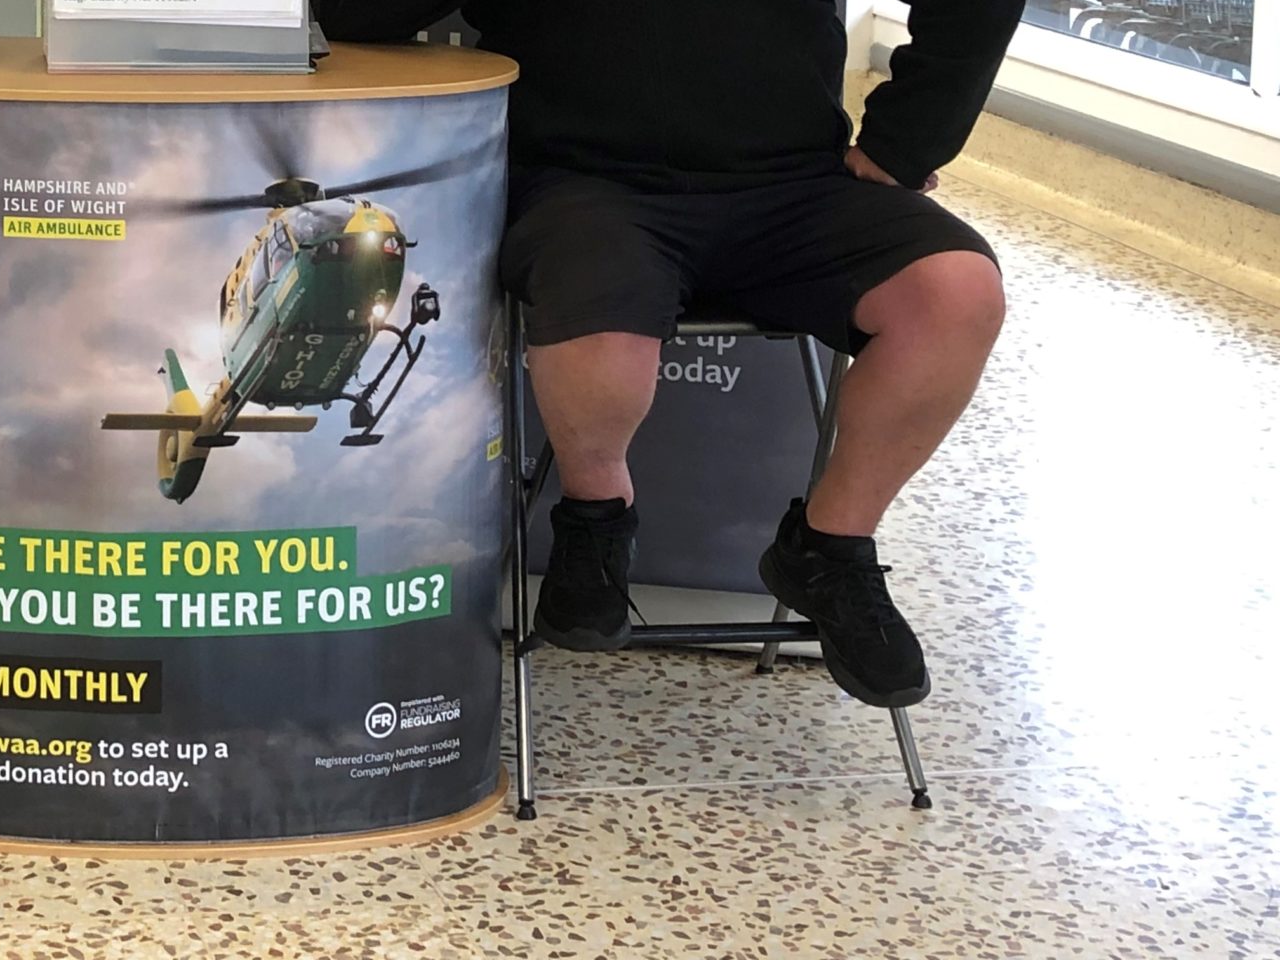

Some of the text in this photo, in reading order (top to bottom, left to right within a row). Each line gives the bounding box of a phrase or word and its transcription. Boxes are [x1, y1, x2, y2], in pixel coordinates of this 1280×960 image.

[3, 178, 127, 196] HAMPSHIRE AND
[3, 198, 127, 215] ISLE OF WIGHT
[8, 221, 122, 237] AIR AMBULANCE
[19, 537, 147, 576] THERE
[161, 541, 240, 576] FOR
[254, 536, 349, 574] YOU.
[92, 592, 142, 628] BE
[156, 591, 282, 628] THERE
[297, 586, 372, 624] FOR
[385, 574, 445, 618] US?
[400, 698, 461, 718] FUNDRAISING
[371, 713, 392, 729] FR
[400, 708, 461, 730] REGULATOR
[98, 739, 125, 759] to
[131, 739, 169, 760] set
[176, 742, 208, 765] up
[214, 742, 229, 759] a
[315, 755, 363, 769] Registered
[364, 751, 395, 764] Charity
[395, 744, 430, 758] Number:
[112, 765, 190, 793] today.
[350, 765, 391, 779] Company
[392, 759, 427, 773] Number:
